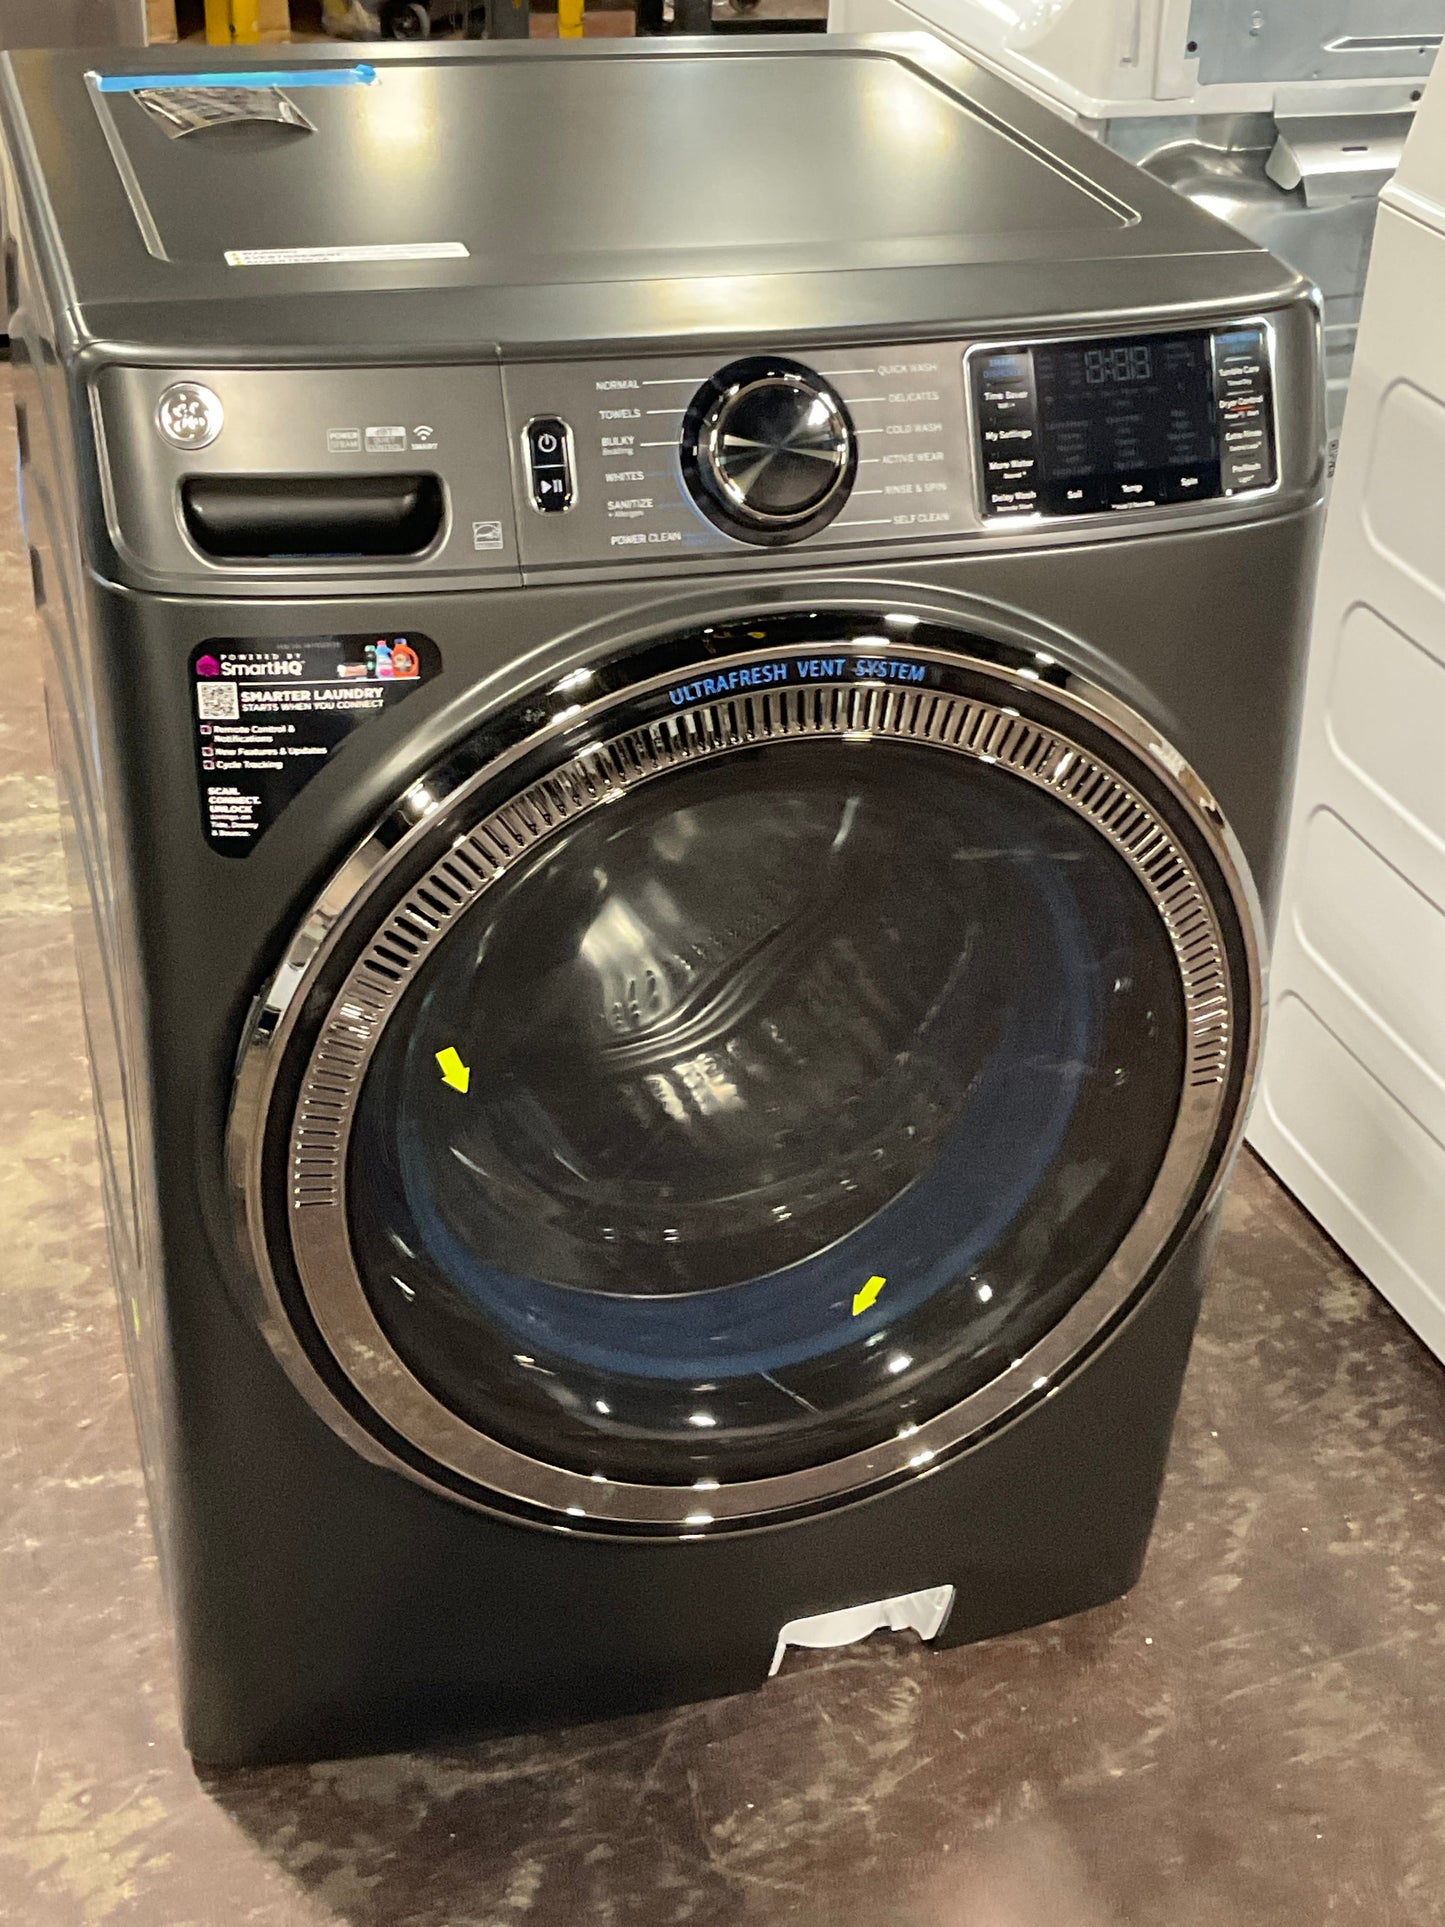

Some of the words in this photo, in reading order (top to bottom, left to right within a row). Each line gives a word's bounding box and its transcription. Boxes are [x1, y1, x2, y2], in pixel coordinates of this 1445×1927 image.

[877, 364, 909, 377] QUICK
[909, 362, 938, 373] WASH
[595, 380, 640, 391] NORMAL
[888, 390, 940, 403] DELICATES
[598, 408, 641, 420] TOWELS
[886, 424, 912, 435] COLD
[913, 422, 943, 434] WASH
[601, 435, 635, 447] BULKY
[882, 453, 915, 464] ACTIVE
[917, 451, 945, 462] WEAR
[604, 470, 645, 482] WHITES
[884, 484, 913, 496] RINSE
[923, 482, 948, 492] SPIN
[607, 498, 654, 510] SANITIZE
[893, 514, 916, 525] SELF
[916, 512, 950, 523] CLEAN
[611, 533, 647, 546] POWER
[648, 530, 683, 543] CLEAN
[220, 653, 280, 661] POWERED
[286, 652, 301, 660] BY
[668, 663, 788, 706] ULTRAFRESH
[797, 658, 847, 678] VENT
[855, 658, 926, 682] SYSTEM
[240, 690, 312, 703] SMARTER
[313, 687, 384, 701] LAUNDRY
[241, 703, 280, 712] STARTS
[280, 701, 313, 711] WHEN
[314, 701, 335, 711] YOU
[336, 699, 384, 710] CONNECT
[213, 725, 250, 734] Remote
[250, 724, 287, 734] Control
[216, 760, 243, 770] Cycle
[243, 760, 284, 770] Tracking
